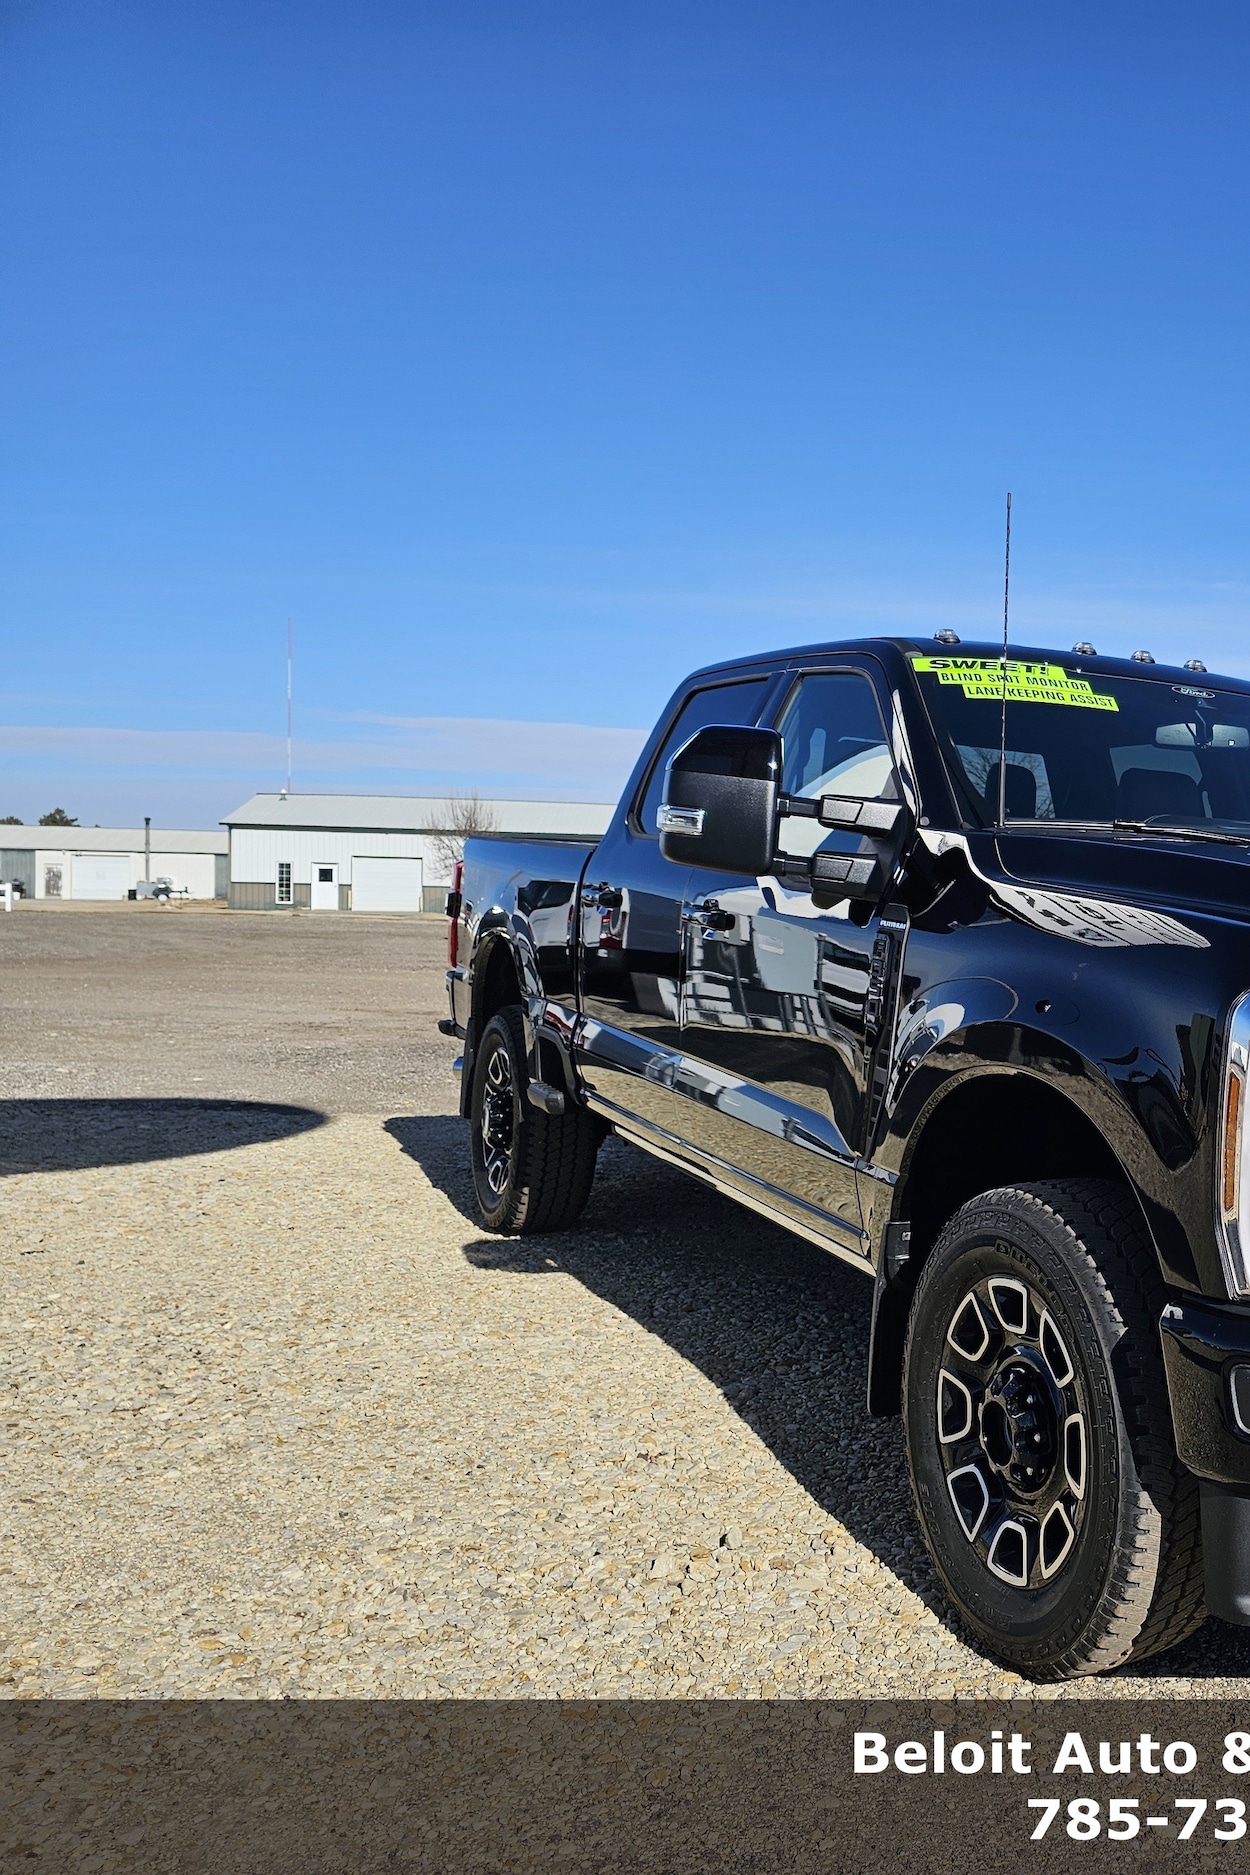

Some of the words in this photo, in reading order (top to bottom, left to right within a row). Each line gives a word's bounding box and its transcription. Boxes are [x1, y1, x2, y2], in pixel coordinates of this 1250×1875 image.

[929, 659, 1049, 675] SWEET!
[941, 672, 982, 682] BLIND
[988, 673, 1021, 684] SPOT
[1026, 677, 1089, 692] MONITOR
[967, 684, 1003, 697] LANE
[1008, 687, 1065, 702] KEEPING
[1070, 694, 1114, 708] ASSIST
